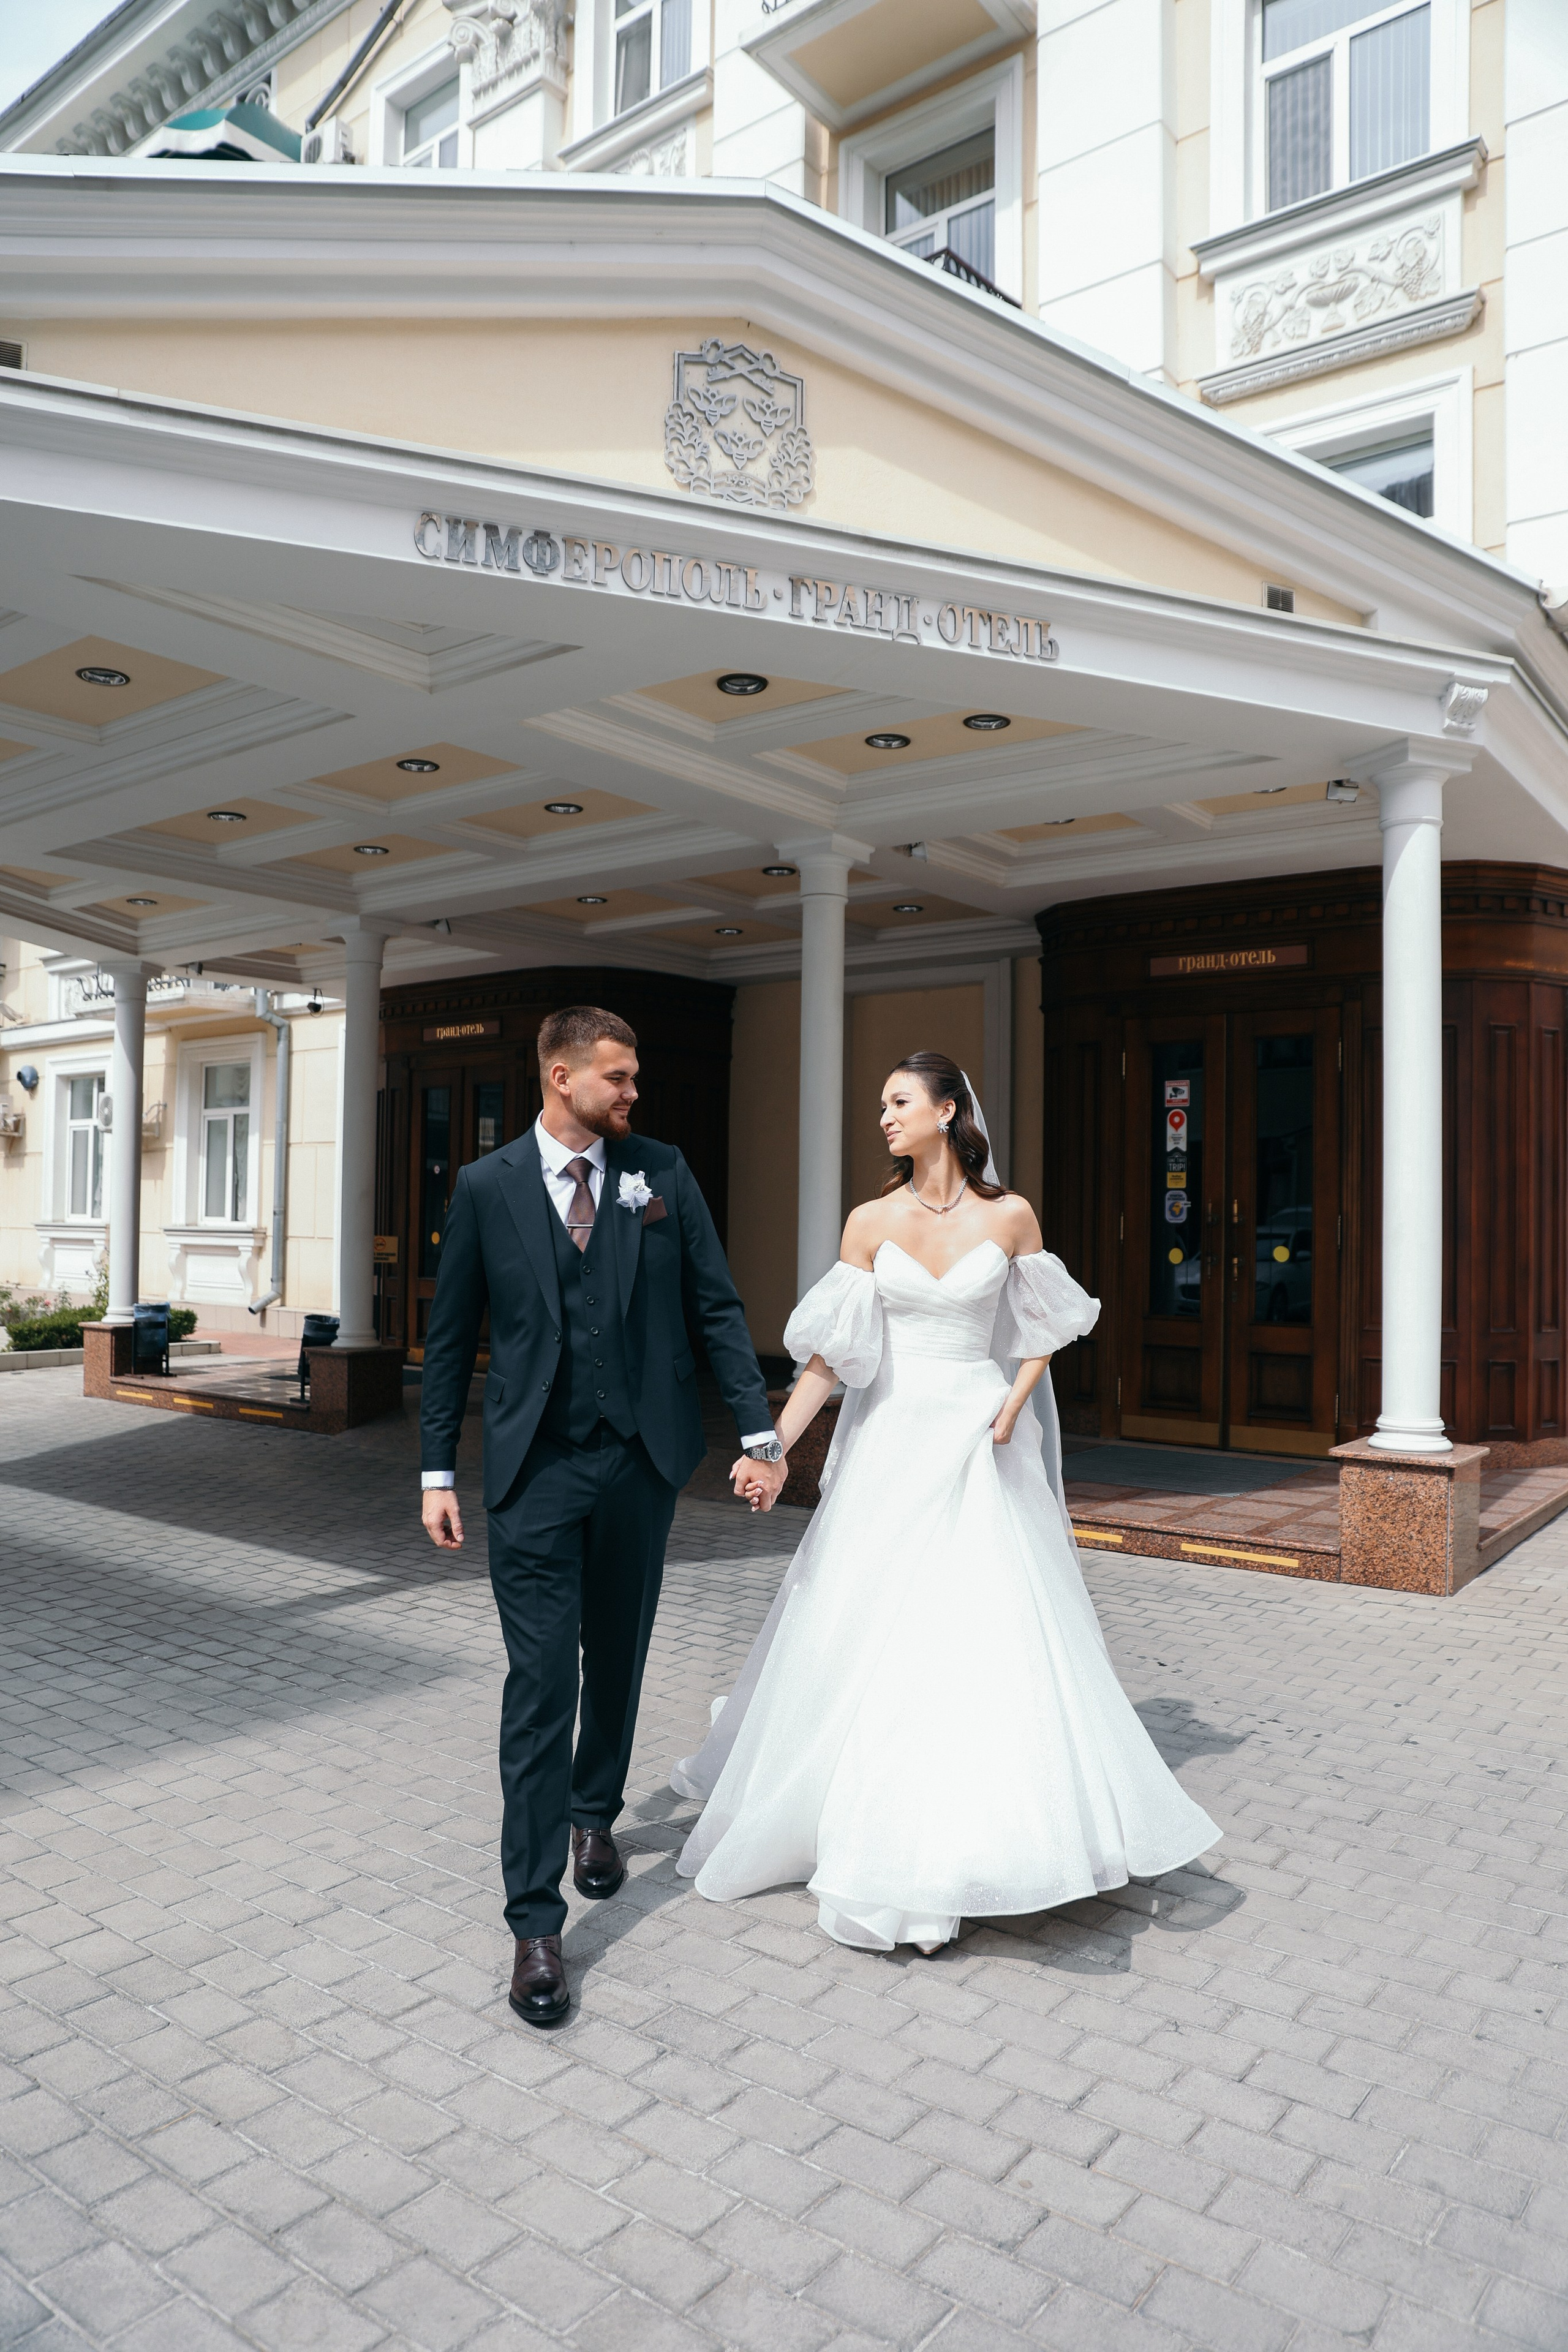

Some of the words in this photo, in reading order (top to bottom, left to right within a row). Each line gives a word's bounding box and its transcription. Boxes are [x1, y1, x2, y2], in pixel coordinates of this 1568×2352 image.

[726, 474, 753, 487] 1959
[414, 512, 767, 610] СИМФЕРОПОЛЬ
[788, 576, 922, 645] ГРАНД
[937, 603, 1060, 660] ОТЕЛЬ
